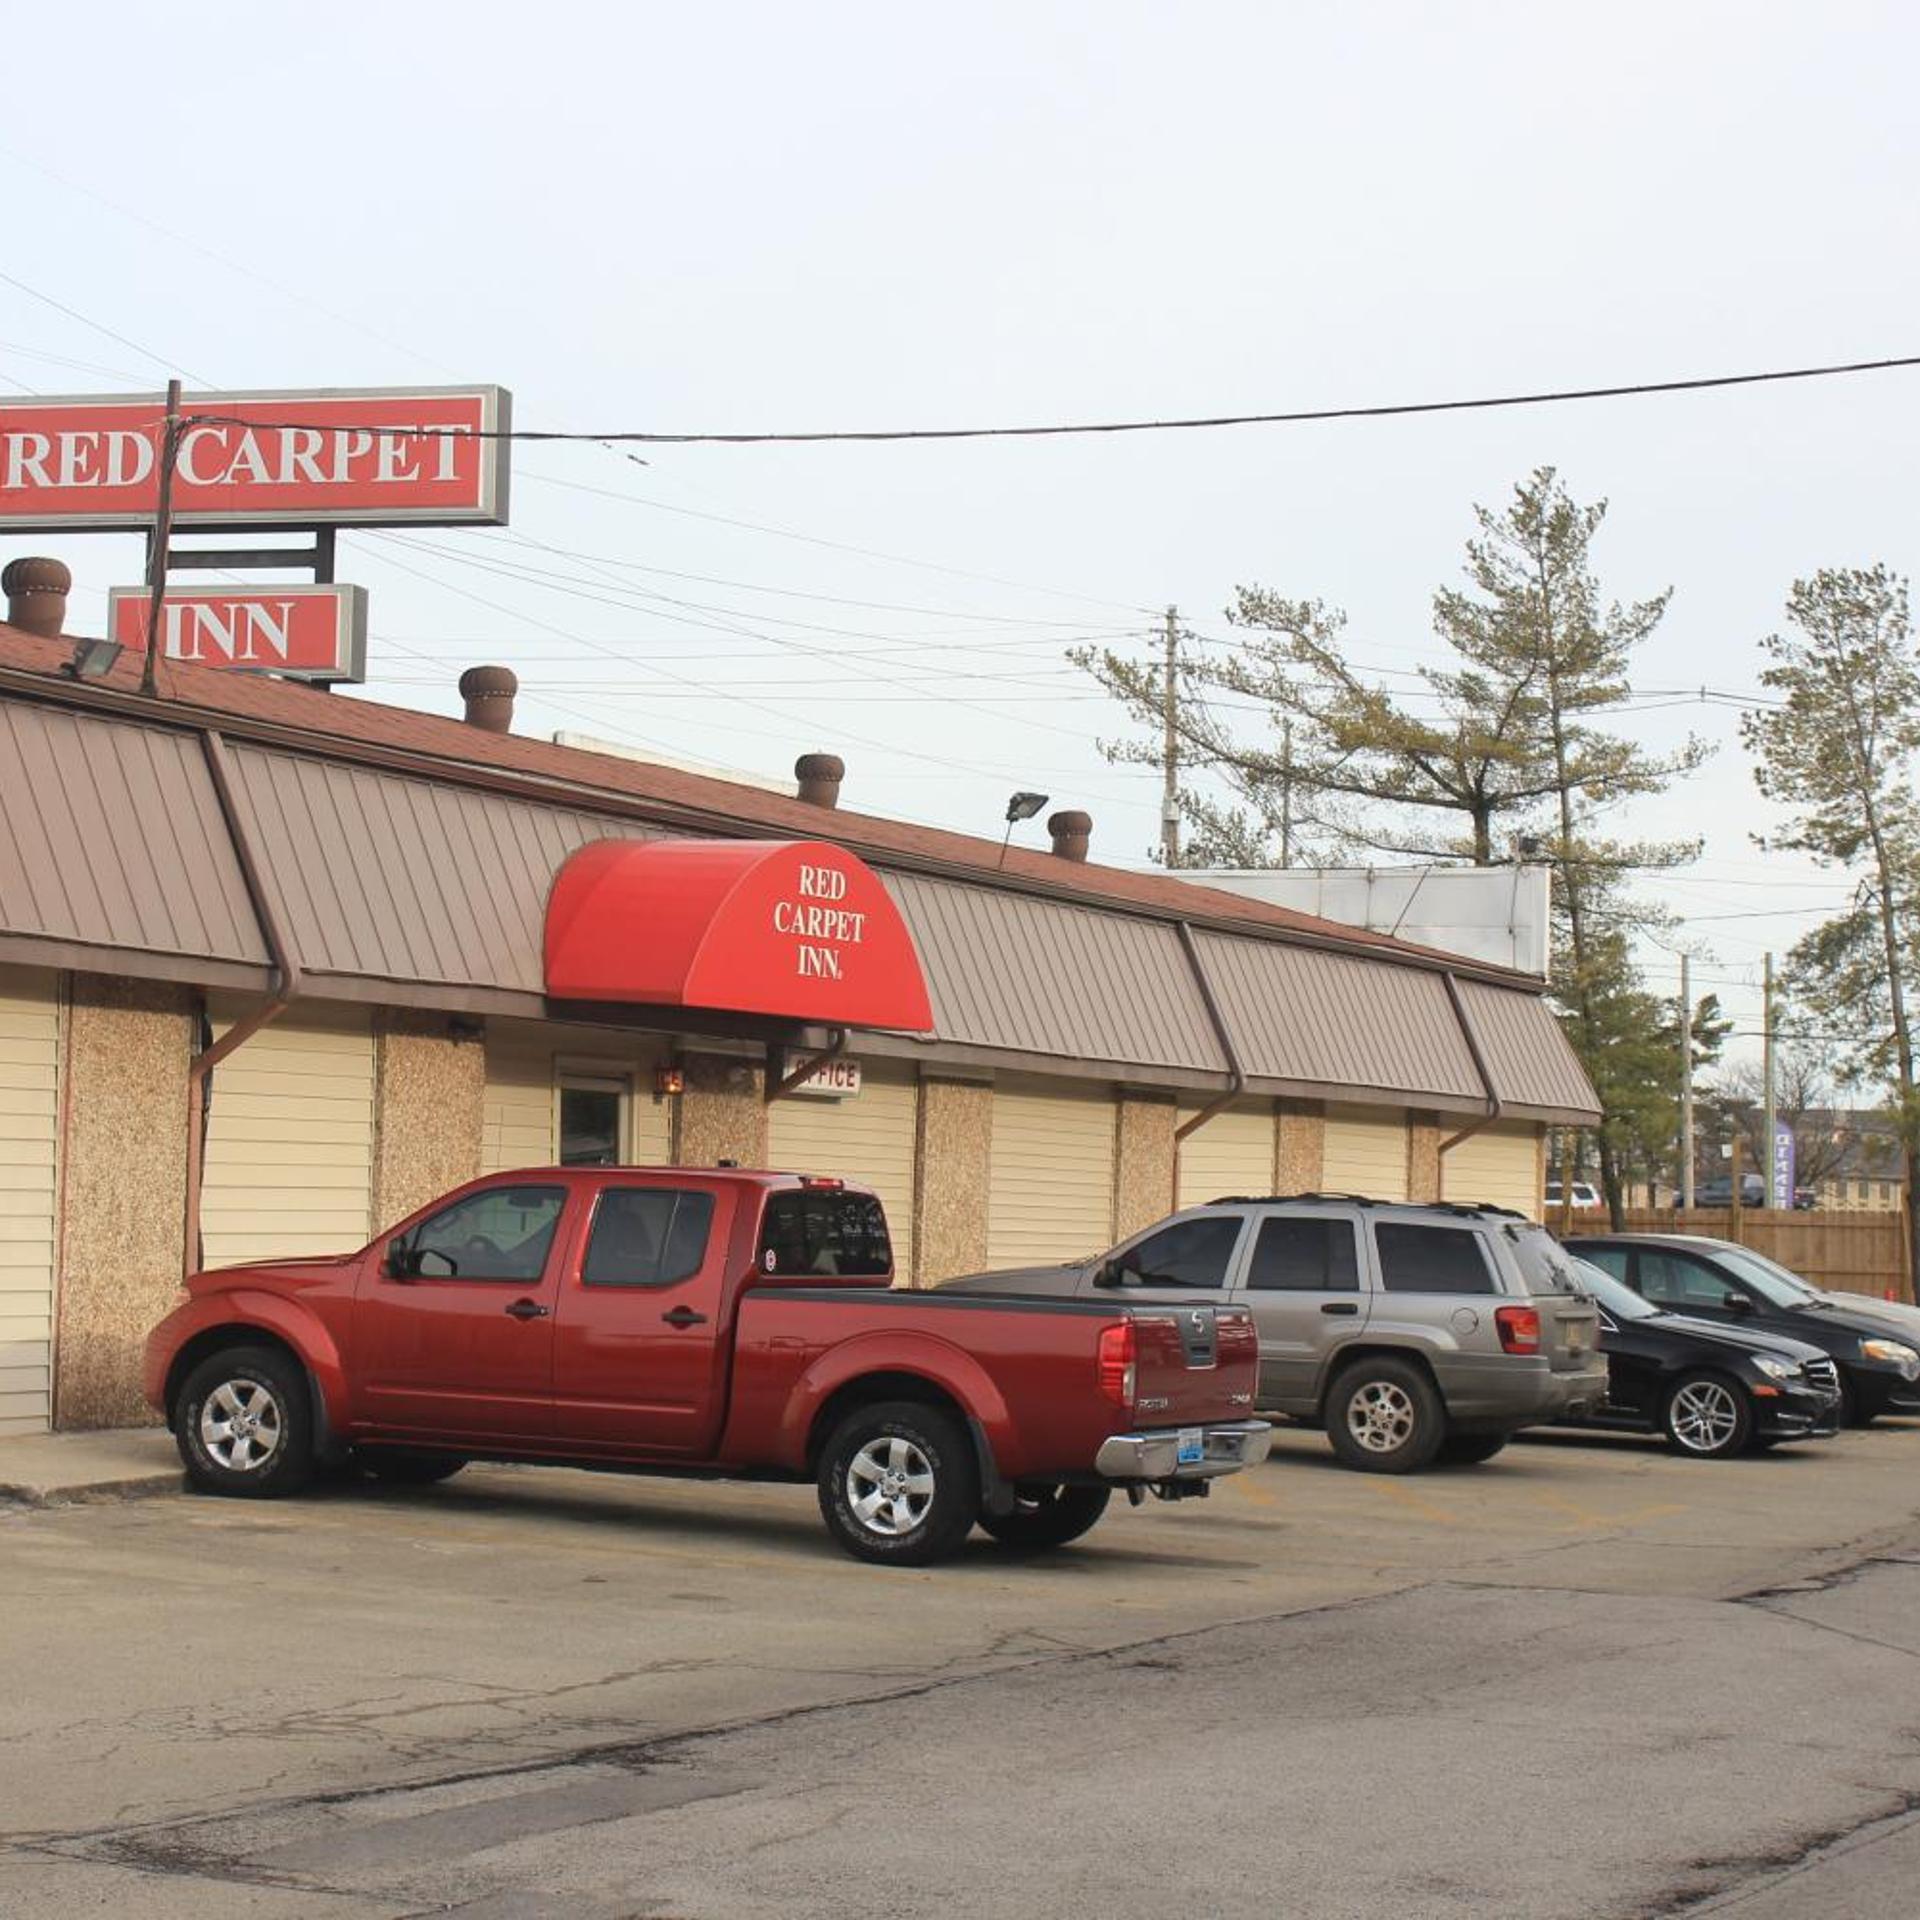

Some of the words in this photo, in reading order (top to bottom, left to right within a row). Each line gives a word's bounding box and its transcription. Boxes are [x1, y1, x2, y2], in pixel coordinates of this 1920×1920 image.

[1, 431, 154, 488] RED
[176, 424, 472, 486] CARPET
[163, 601, 295, 661] INN
[799, 865, 845, 900] RED
[774, 902, 865, 943] CARPET
